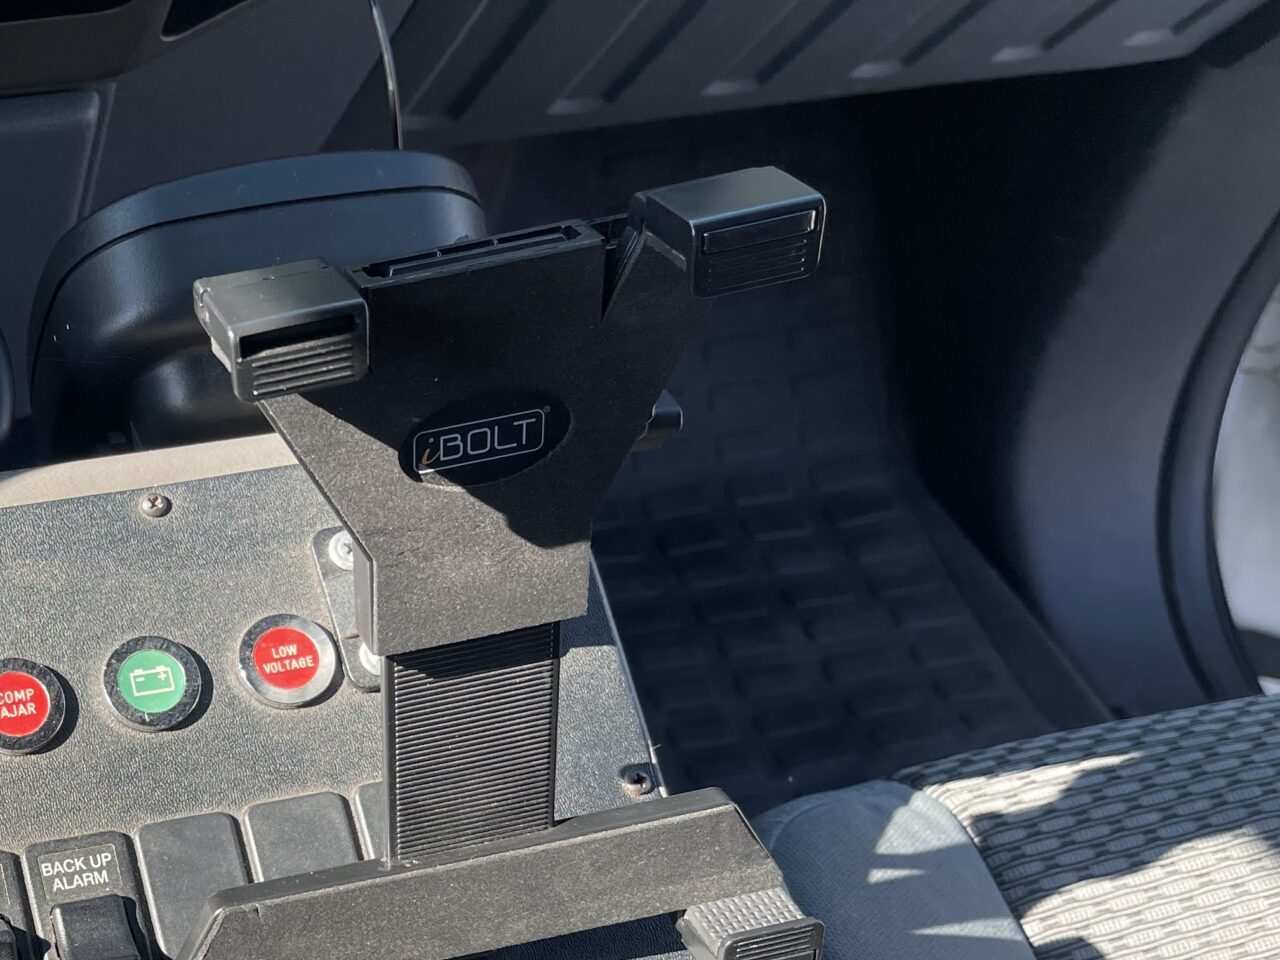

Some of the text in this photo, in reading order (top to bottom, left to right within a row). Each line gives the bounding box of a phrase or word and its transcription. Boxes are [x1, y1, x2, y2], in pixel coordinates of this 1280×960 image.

[271, 644, 298, 659] LOW
[263, 655, 315, 674] VOLTAGE
[0, 703, 38, 721] AJAR
[40, 852, 113, 878] BACK UP
[53, 869, 110, 893] ALARM
